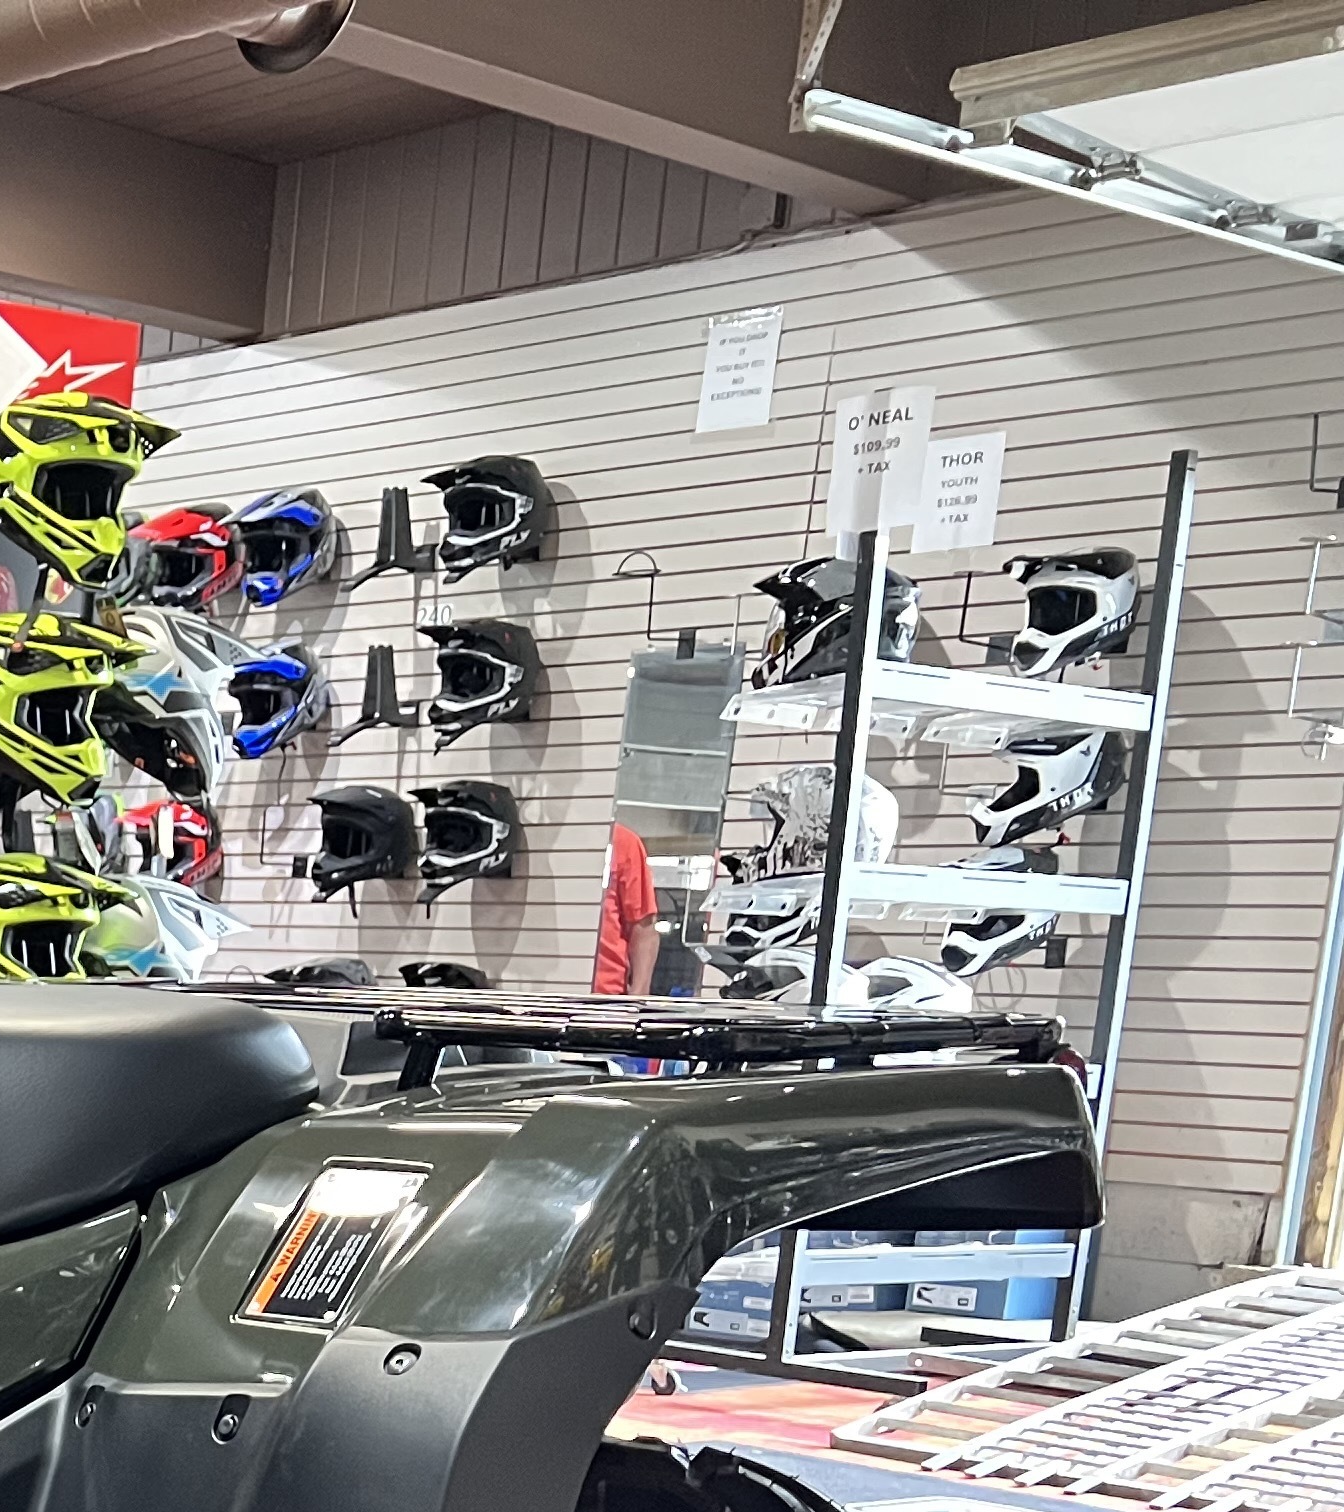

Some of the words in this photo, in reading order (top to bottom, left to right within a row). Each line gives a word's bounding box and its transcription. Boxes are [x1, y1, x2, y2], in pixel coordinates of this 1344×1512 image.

[848, 415, 864, 431] O'
[868, 406, 914, 428] NEAL
[853, 436, 901, 456] $109.99
[867, 461, 892, 474] TAX
[941, 451, 984, 469] THOR
[941, 476, 979, 489] YOUTH
[949, 513, 969, 523] TAX
[417, 604, 453, 625] 240
